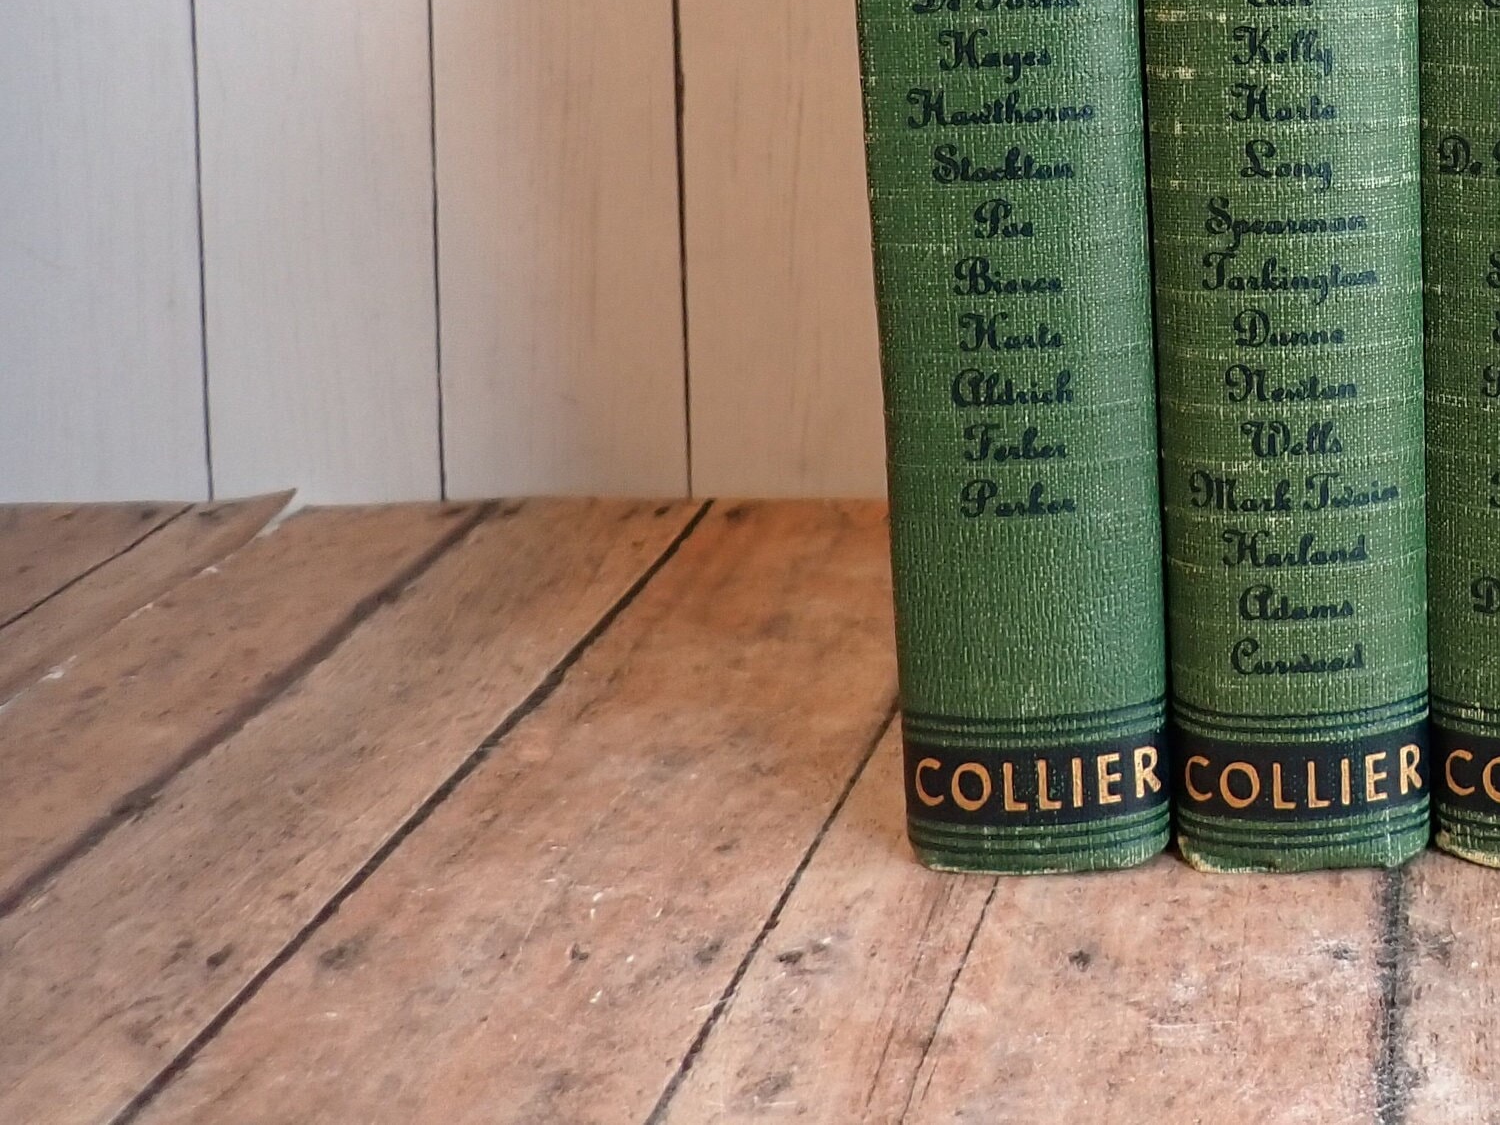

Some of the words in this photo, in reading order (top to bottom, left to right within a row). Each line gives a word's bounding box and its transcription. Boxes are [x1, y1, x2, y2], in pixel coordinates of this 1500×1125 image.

[1232, 25, 1333, 76] Kelly
[906, 88, 1094, 130] Hawthorne
[1229, 82, 1338, 123] Harte
[932, 144, 1074, 184] Stockton
[1240, 139, 1333, 194] Long
[1438, 135, 1483, 176] De
[974, 198, 1034, 238] Poe
[1205, 196, 1367, 252] Spearman
[954, 255, 1063, 296] Bierce
[1202, 251, 1379, 306] Tarkington
[958, 311, 1065, 352] Harte
[952, 368, 1073, 408] Aldrich
[1240, 421, 1344, 458] Wells
[960, 478, 1076, 518] Parker
[1189, 470, 1292, 512] Mark
[1303, 473, 1400, 512] Twain
[1221, 529, 1368, 568] Harland
[1238, 584, 1354, 621] Adams
[915, 745, 1162, 811] COLLIER
[1185, 743, 1422, 809] COLLIER
